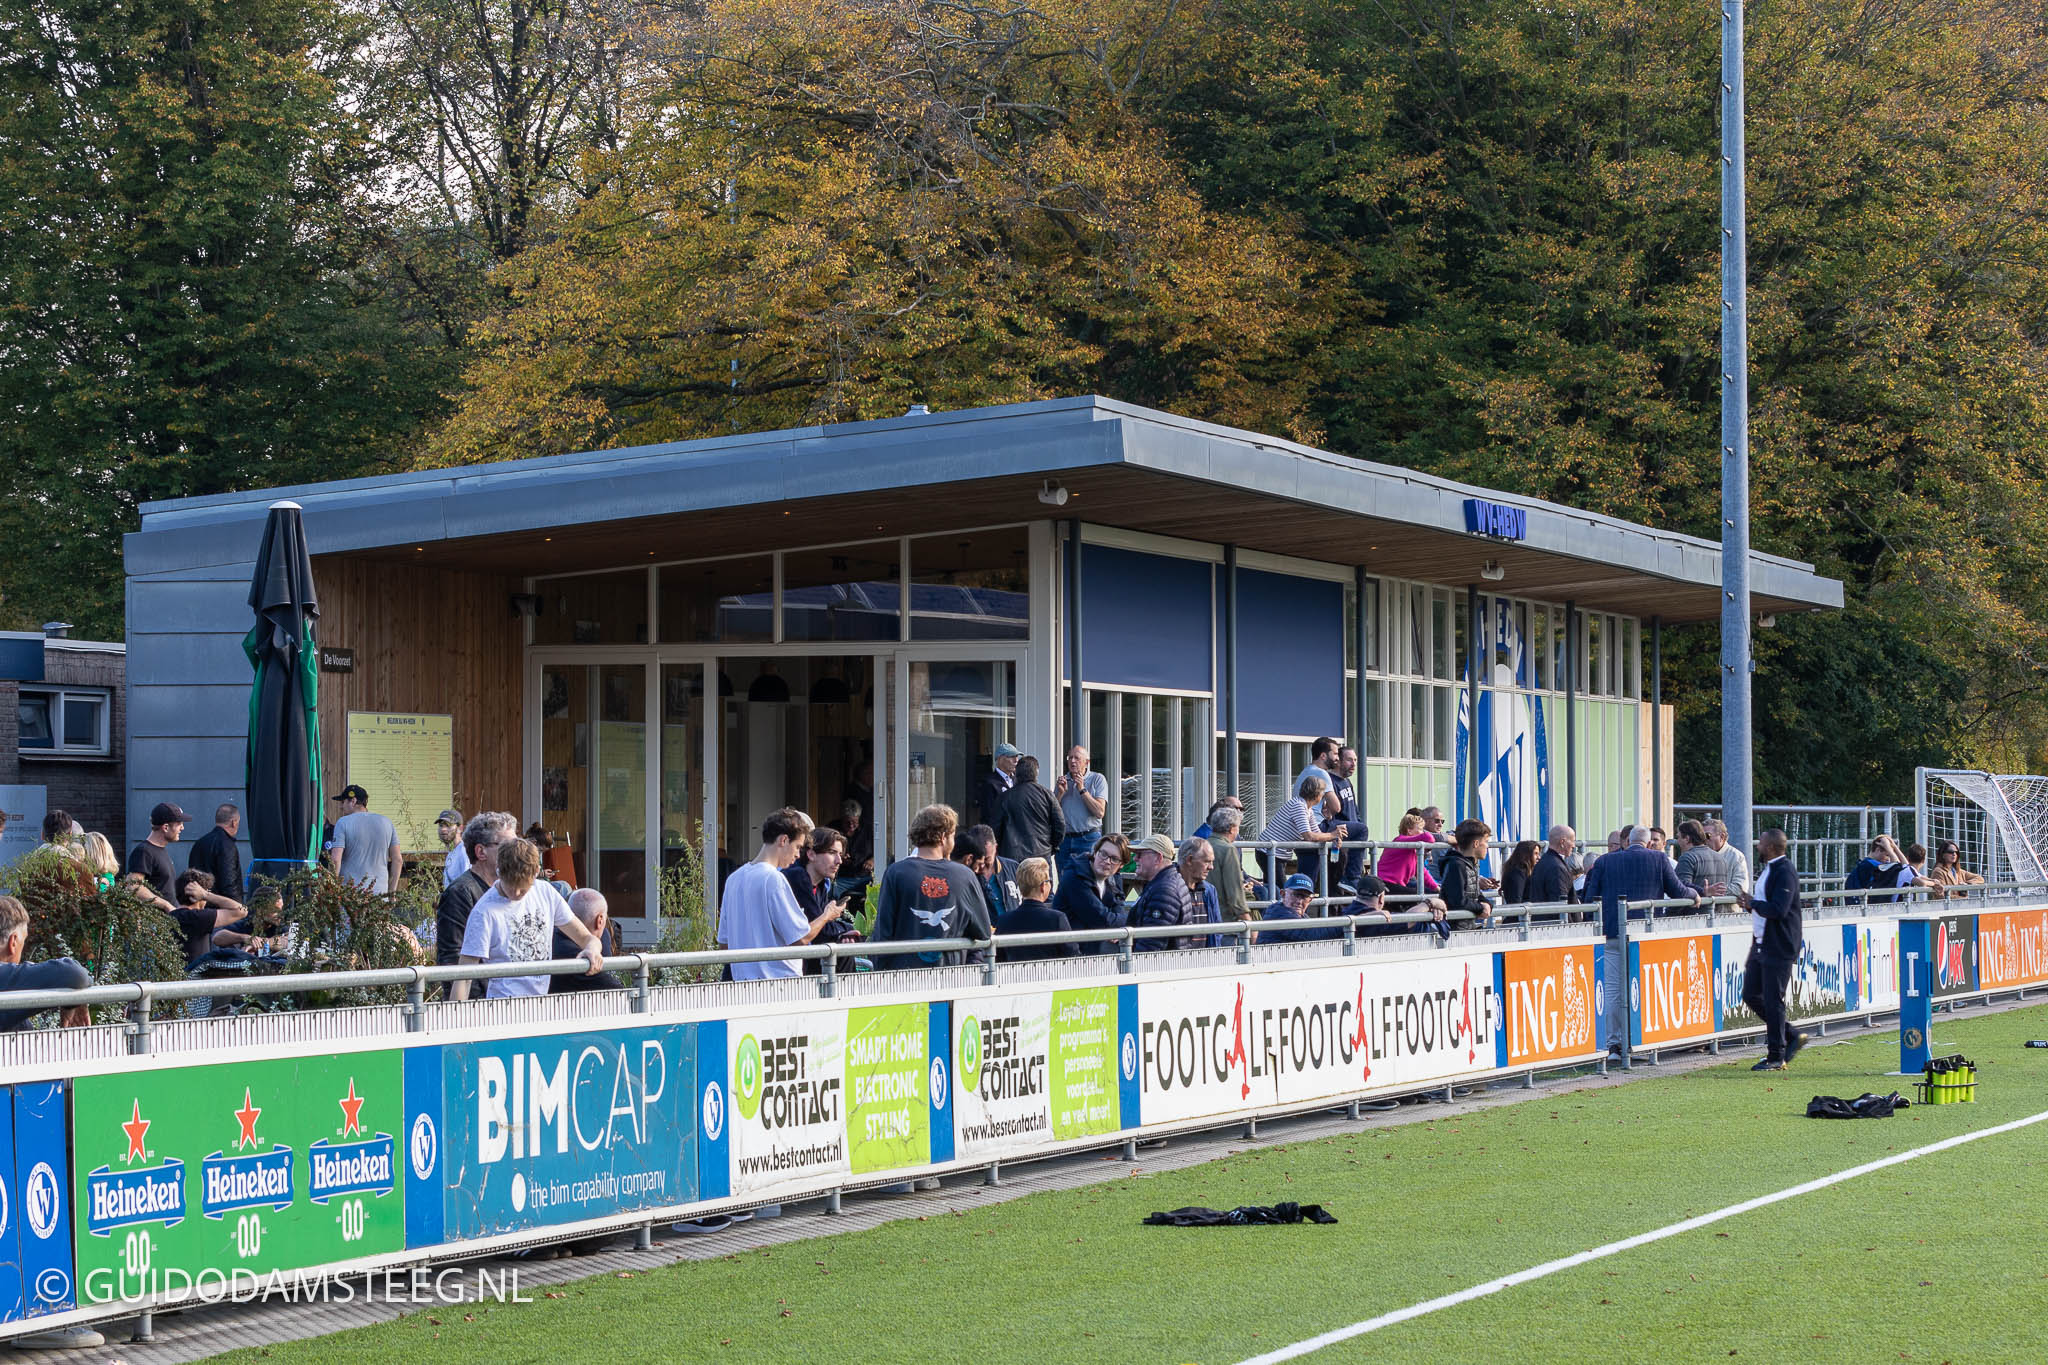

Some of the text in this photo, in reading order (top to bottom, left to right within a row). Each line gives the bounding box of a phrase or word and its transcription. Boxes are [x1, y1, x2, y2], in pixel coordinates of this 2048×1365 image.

[324, 653, 333, 665] De
[1980, 925, 2040, 984] ING ING
[1642, 956, 1684, 1034] ING
[1725, 961, 1747, 1008] Hie
[981, 1016, 1020, 1060] BEST
[1509, 975, 1559, 1058] ING
[761, 1035, 808, 1083] BEST
[849, 1035, 887, 1067] SMART
[889, 1031, 923, 1062] HOME
[855, 1070, 919, 1105] ELECTRONIC
[980, 1054, 1045, 1102] CONTACT
[477, 1039, 666, 1165] BIMCAP
[760, 1078, 840, 1130] CONTACT
[865, 1110, 911, 1141] STYLING
[961, 1105, 1047, 1144] www.bestcontact.nl
[313, 1149, 391, 1190] Heineken
[738, 1137, 842, 1175] www.bestcontact.nl
[93, 1176, 181, 1221] Heineken
[206, 1162, 289, 1204] Heineken
[530, 1169, 666, 1209] the bim capability company
